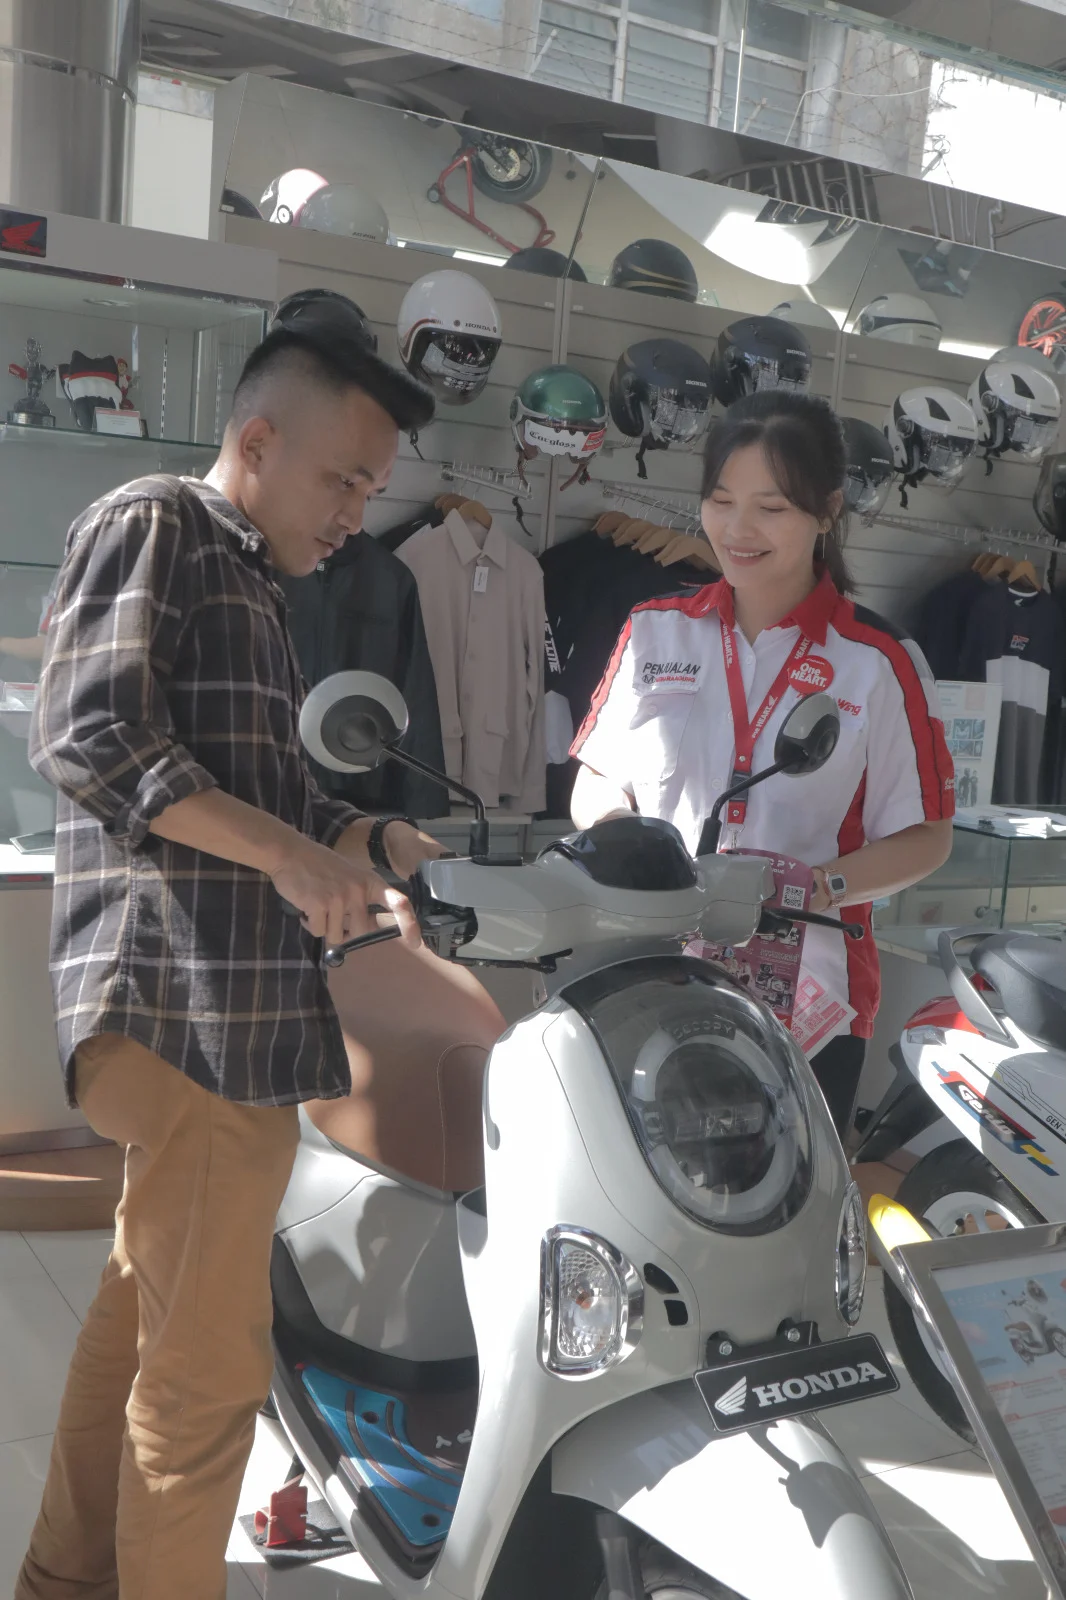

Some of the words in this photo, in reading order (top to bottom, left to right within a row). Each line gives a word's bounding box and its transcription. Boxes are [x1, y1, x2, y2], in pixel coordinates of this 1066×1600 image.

[465, 322, 491, 331] HONDA
[786, 348, 807, 357] HONDA
[685, 379, 708, 388] HONDA
[529, 430, 577, 449] Cargloss
[871, 456, 890, 465] HONDA
[800, 662, 821, 676] One
[751, 1361, 887, 1408] HONDA
